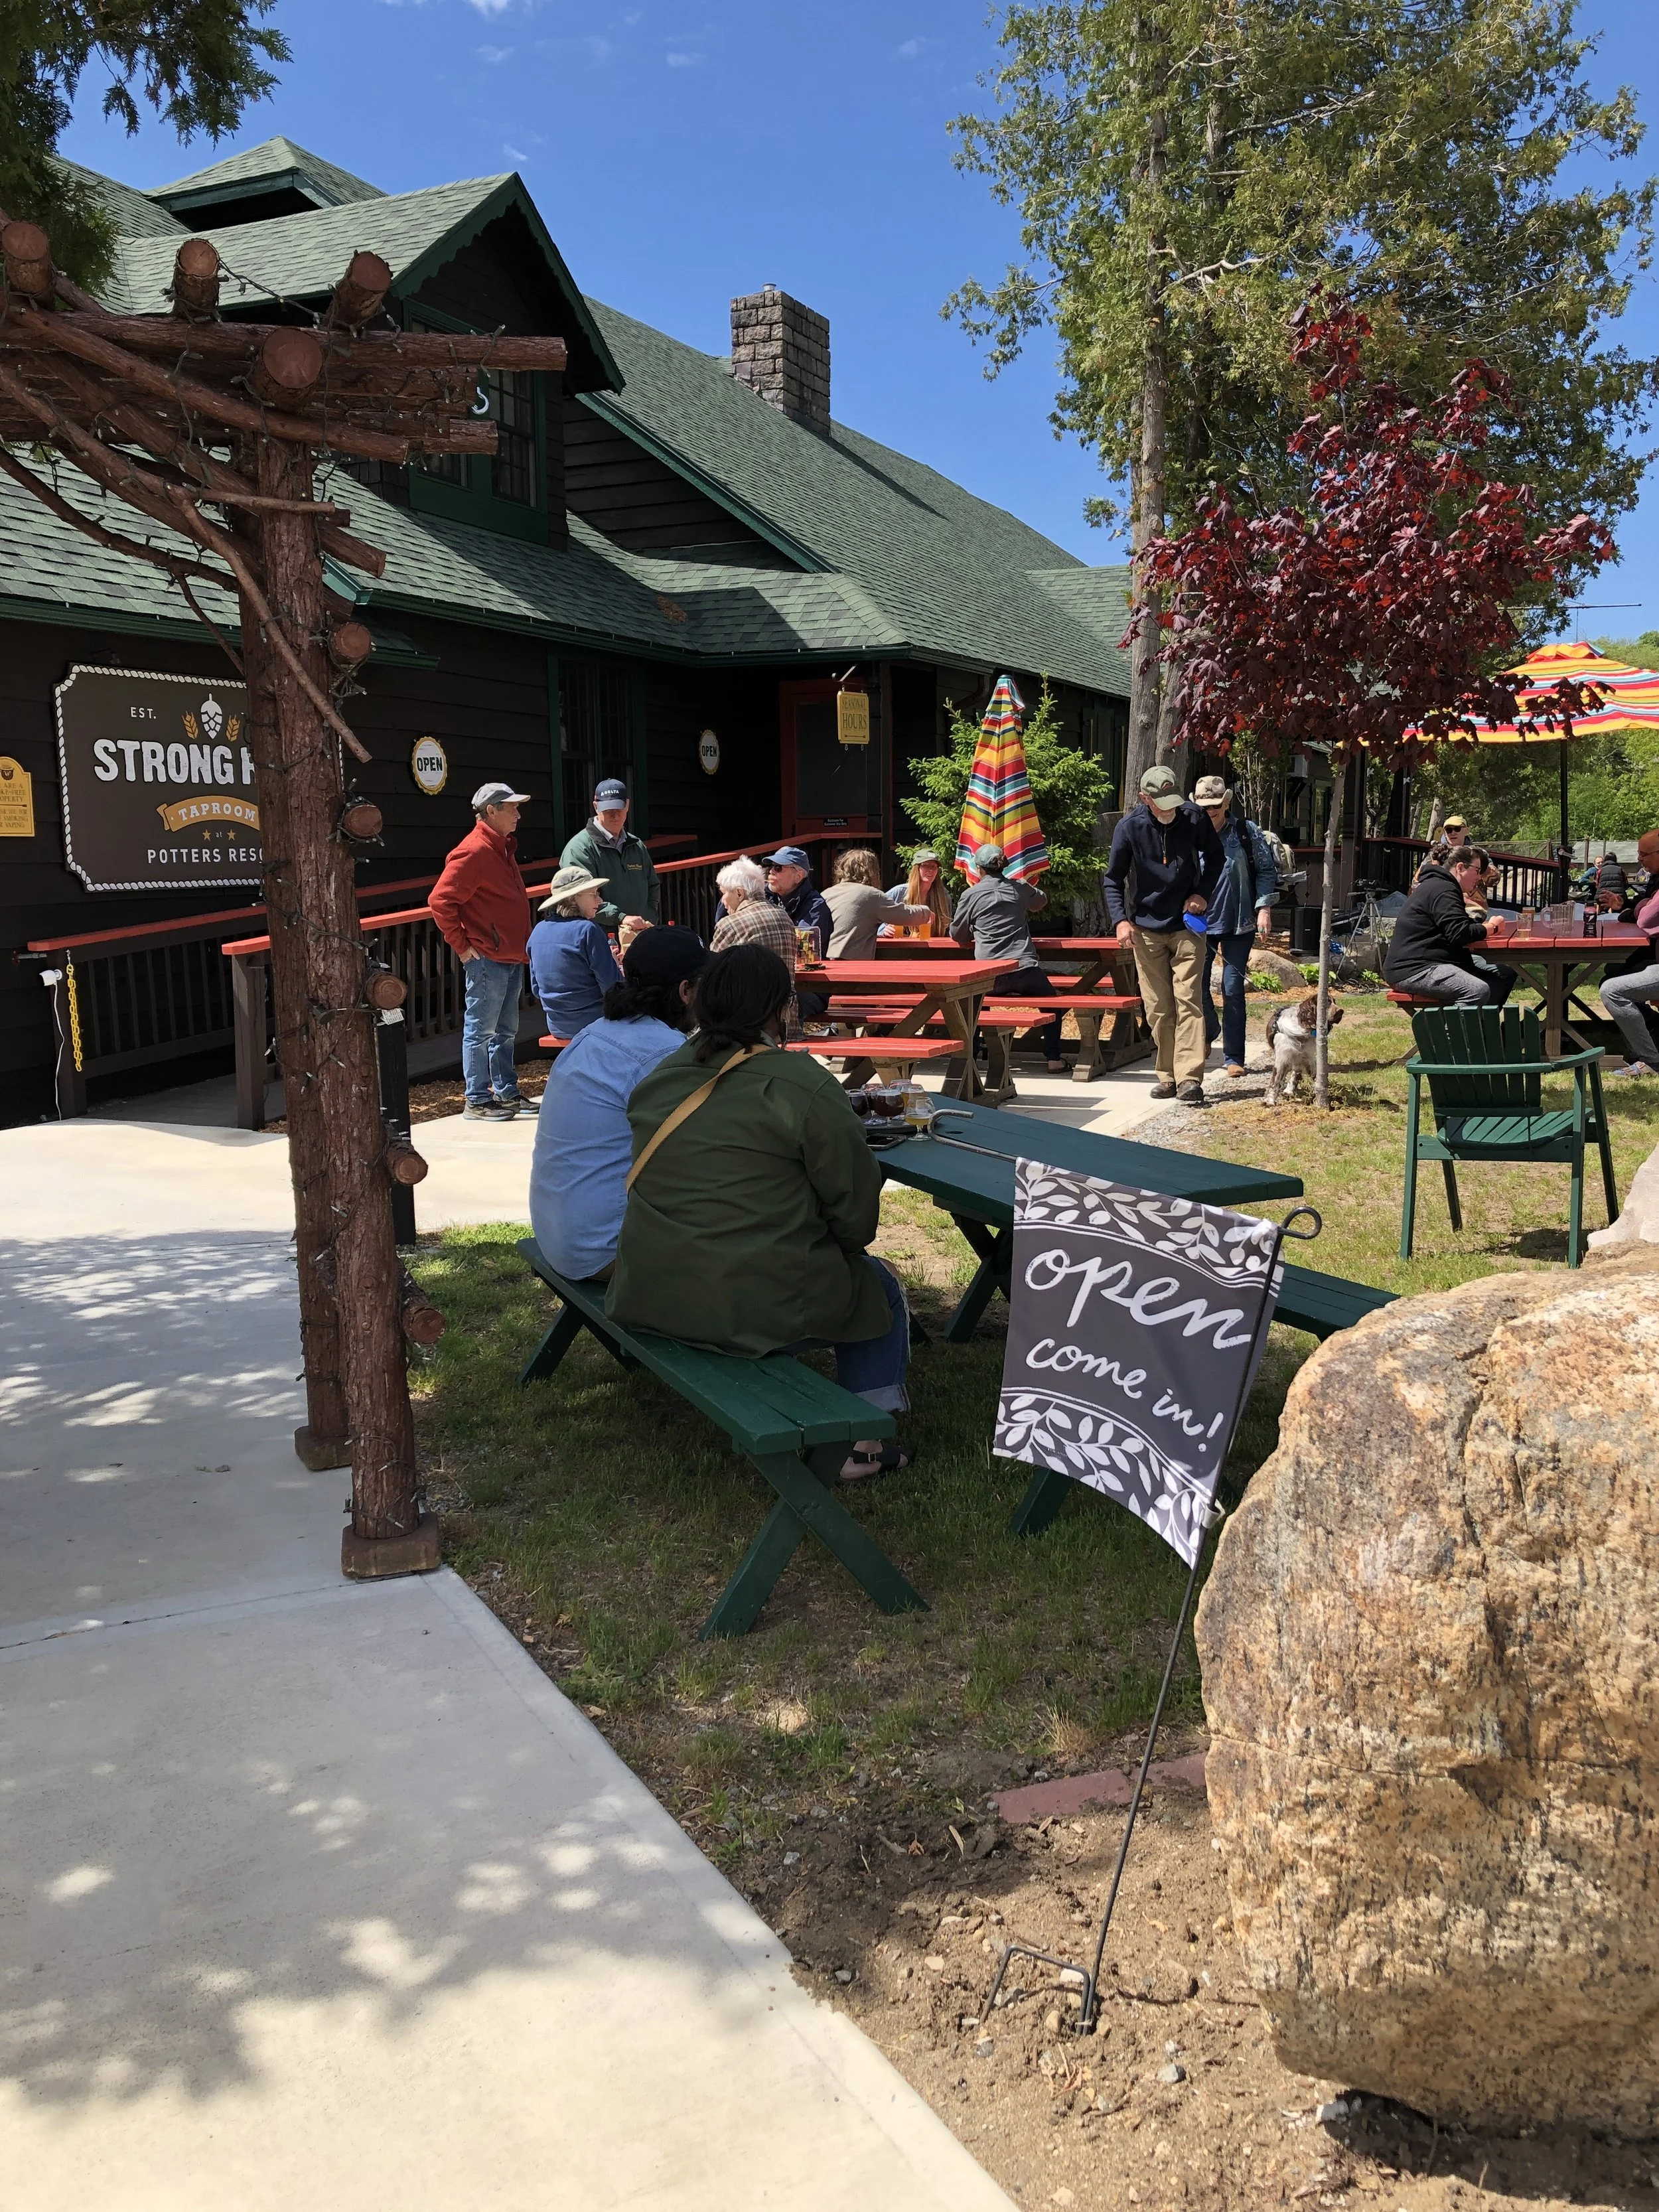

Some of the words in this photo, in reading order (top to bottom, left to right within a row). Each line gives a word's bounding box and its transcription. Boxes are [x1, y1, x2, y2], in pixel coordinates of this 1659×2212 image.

[131, 707, 157, 719] EST.
[842, 713, 867, 729] HOURS
[701, 745, 717, 757] OPEN
[94, 739, 234, 785] STRONG
[417, 757, 443, 772] OPEN
[179, 802, 255, 822] TAPROOM
[147, 848, 221, 863] POTTERS
[1024, 1248, 1253, 1350] open
[1025, 1337, 1147, 1399] come
[1151, 1387, 1224, 1453] in!
